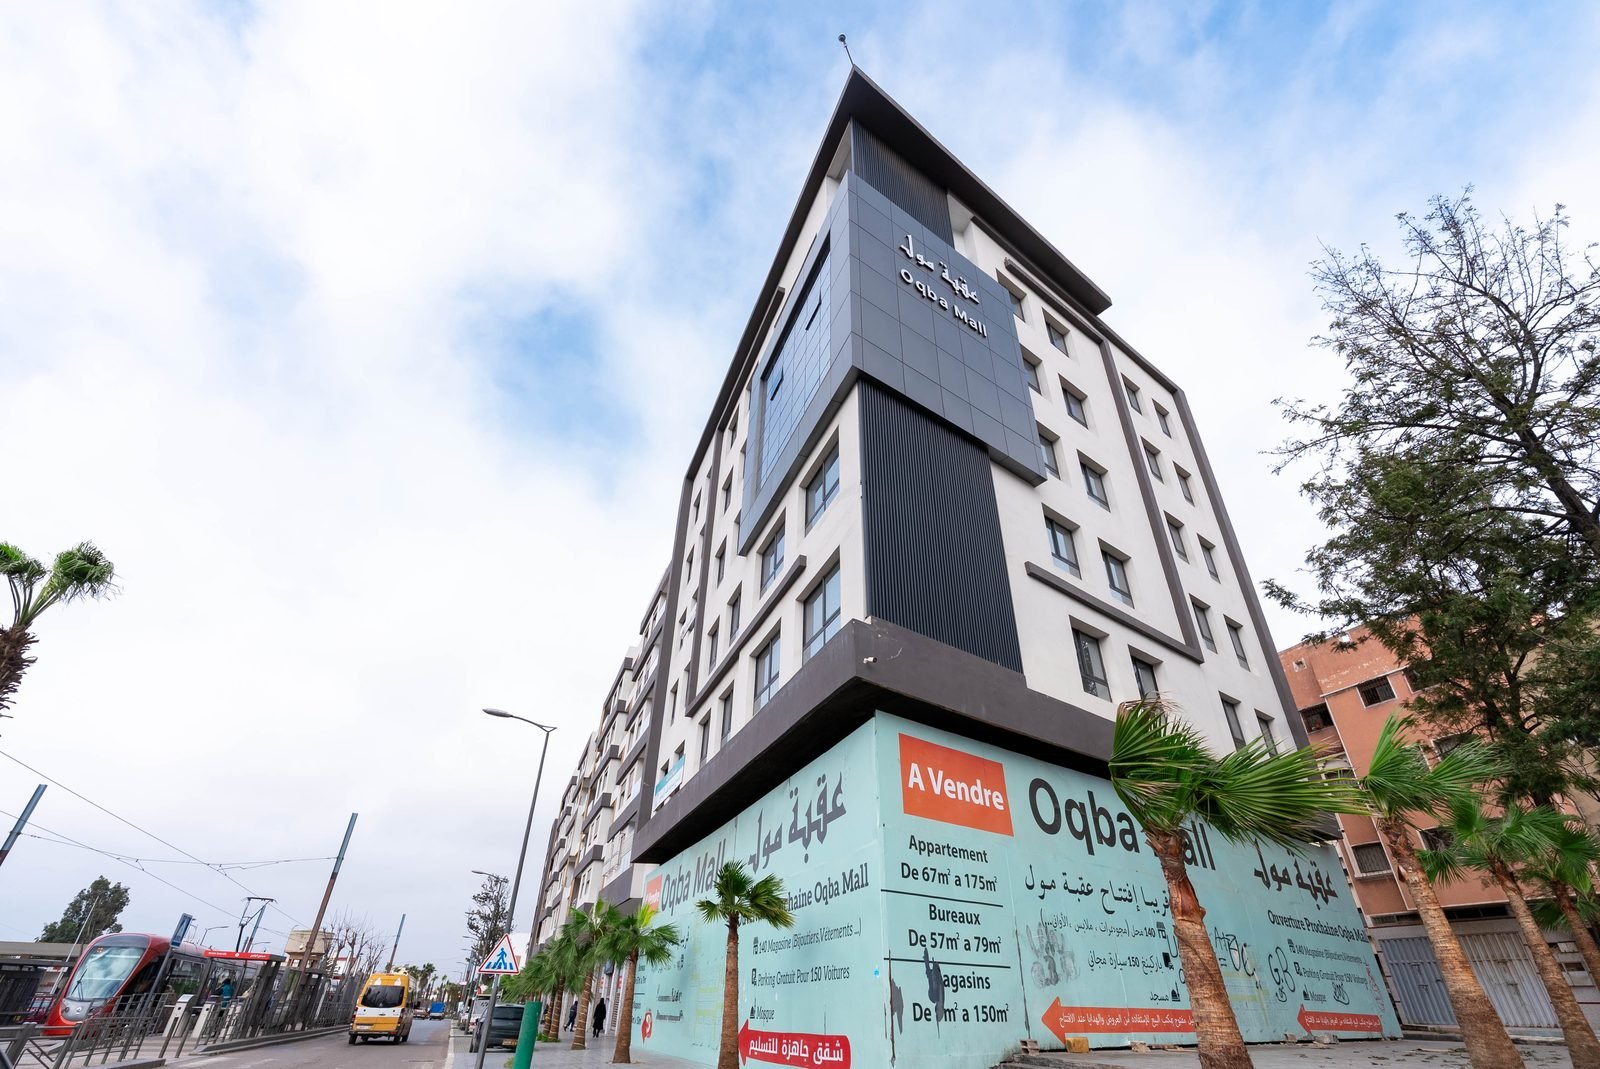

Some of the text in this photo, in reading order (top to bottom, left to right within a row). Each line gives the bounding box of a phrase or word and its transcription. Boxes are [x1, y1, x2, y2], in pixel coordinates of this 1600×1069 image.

[899, 234, 980, 304] عقبة مول
[900, 268, 987, 338] Oqba Mall
[908, 762, 1005, 811] A Vendre
[747, 771, 847, 875] عقبة مول
[1028, 777, 1141, 856] Oqba
[908, 834, 989, 864] Appartement
[661, 838, 727, 917] Oqba Mall
[814, 877, 841, 906] Oqba
[842, 862, 869, 895] Mall
[900, 861, 919, 881] De
[954, 874, 962, 887] a
[1024, 863, 1057, 900] مول
[1062, 871, 1094, 903] عقبة
[1253, 836, 1339, 911] عقبة مول
[928, 903, 981, 926] Bureaux
[1267, 909, 1306, 931] Ouverture
[1303, 917, 1340, 938] Prochaine
[908, 928, 927, 948] De
[963, 938, 972, 952] a
[1131, 924, 1144, 938] محل
[1144, 926, 1156, 938] 140
[1108, 951, 1128, 971] سيارة
[1127, 955, 1140, 968] 150
[757, 964, 850, 988] Parking Gratuit Pour 150 Voitures
[943, 970, 991, 993] agasins
[912, 1002, 932, 1022] De
[962, 1008, 970, 1023] a
[1149, 991, 1170, 1006] مسجد
[755, 1005, 776, 1022] Mosque
[748, 1036, 844, 1065] شقق جاهزة للتسليم
